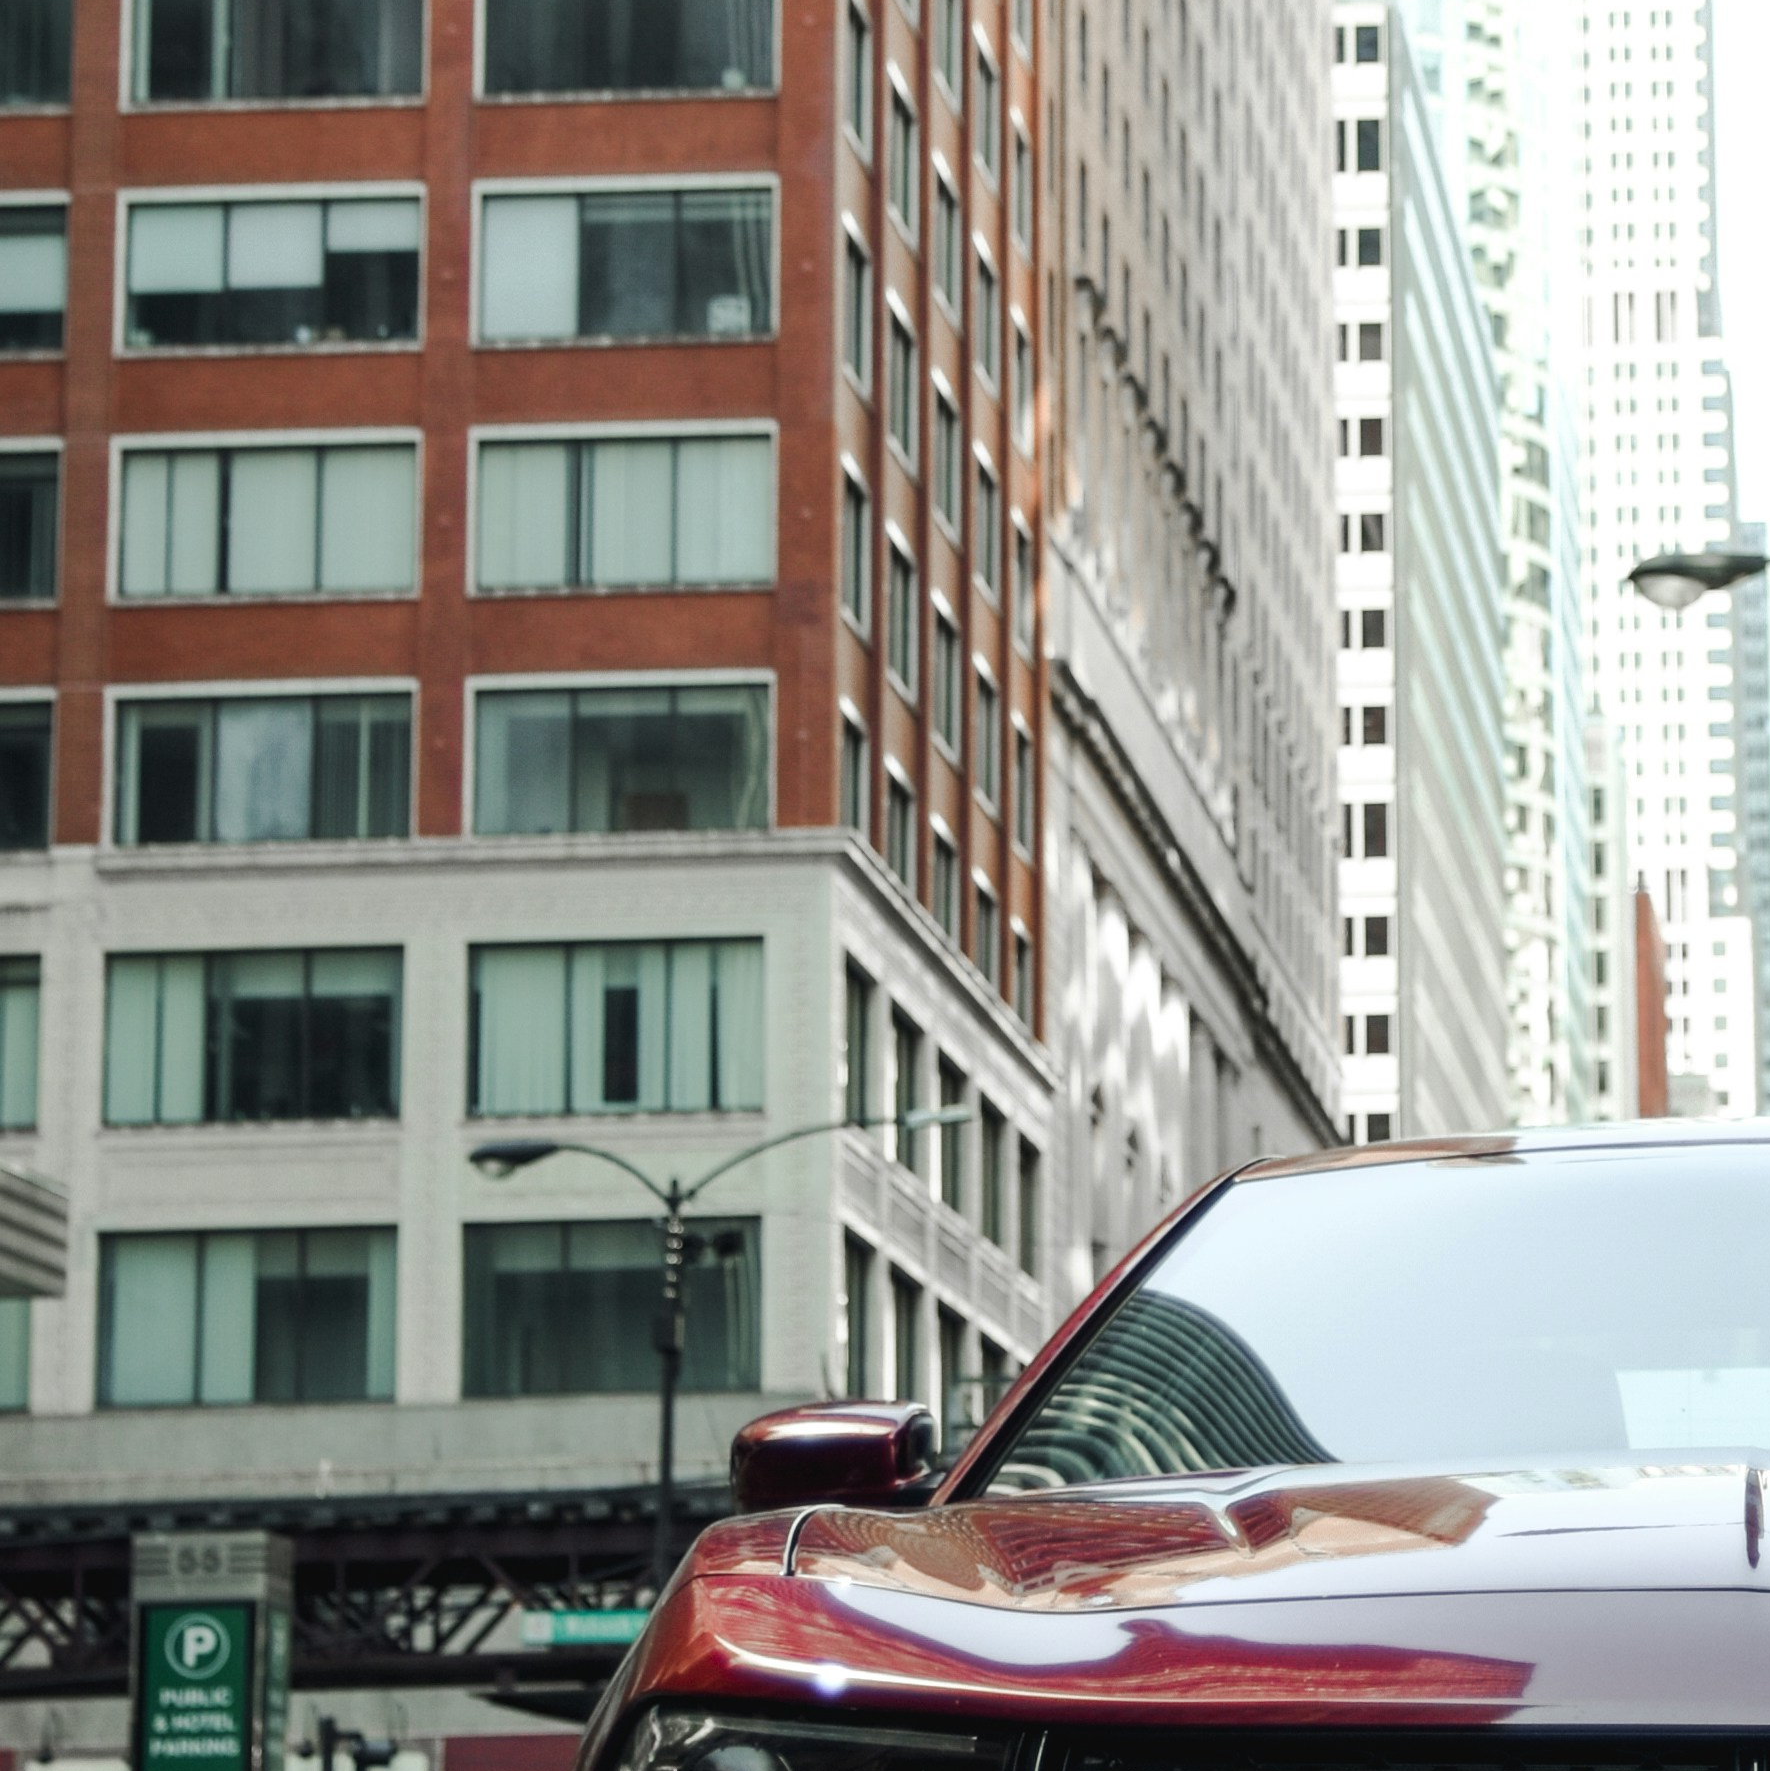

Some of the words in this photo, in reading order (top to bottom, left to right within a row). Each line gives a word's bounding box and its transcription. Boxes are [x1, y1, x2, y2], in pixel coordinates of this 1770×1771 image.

[176, 1546, 223, 1576] 55
[182, 1624, 218, 1669] P
[158, 1686, 233, 1708] PUBLIC
[152, 1712, 168, 1733] &
[170, 1709, 234, 1732] HOTEL
[150, 1736, 240, 1759] PARKING
